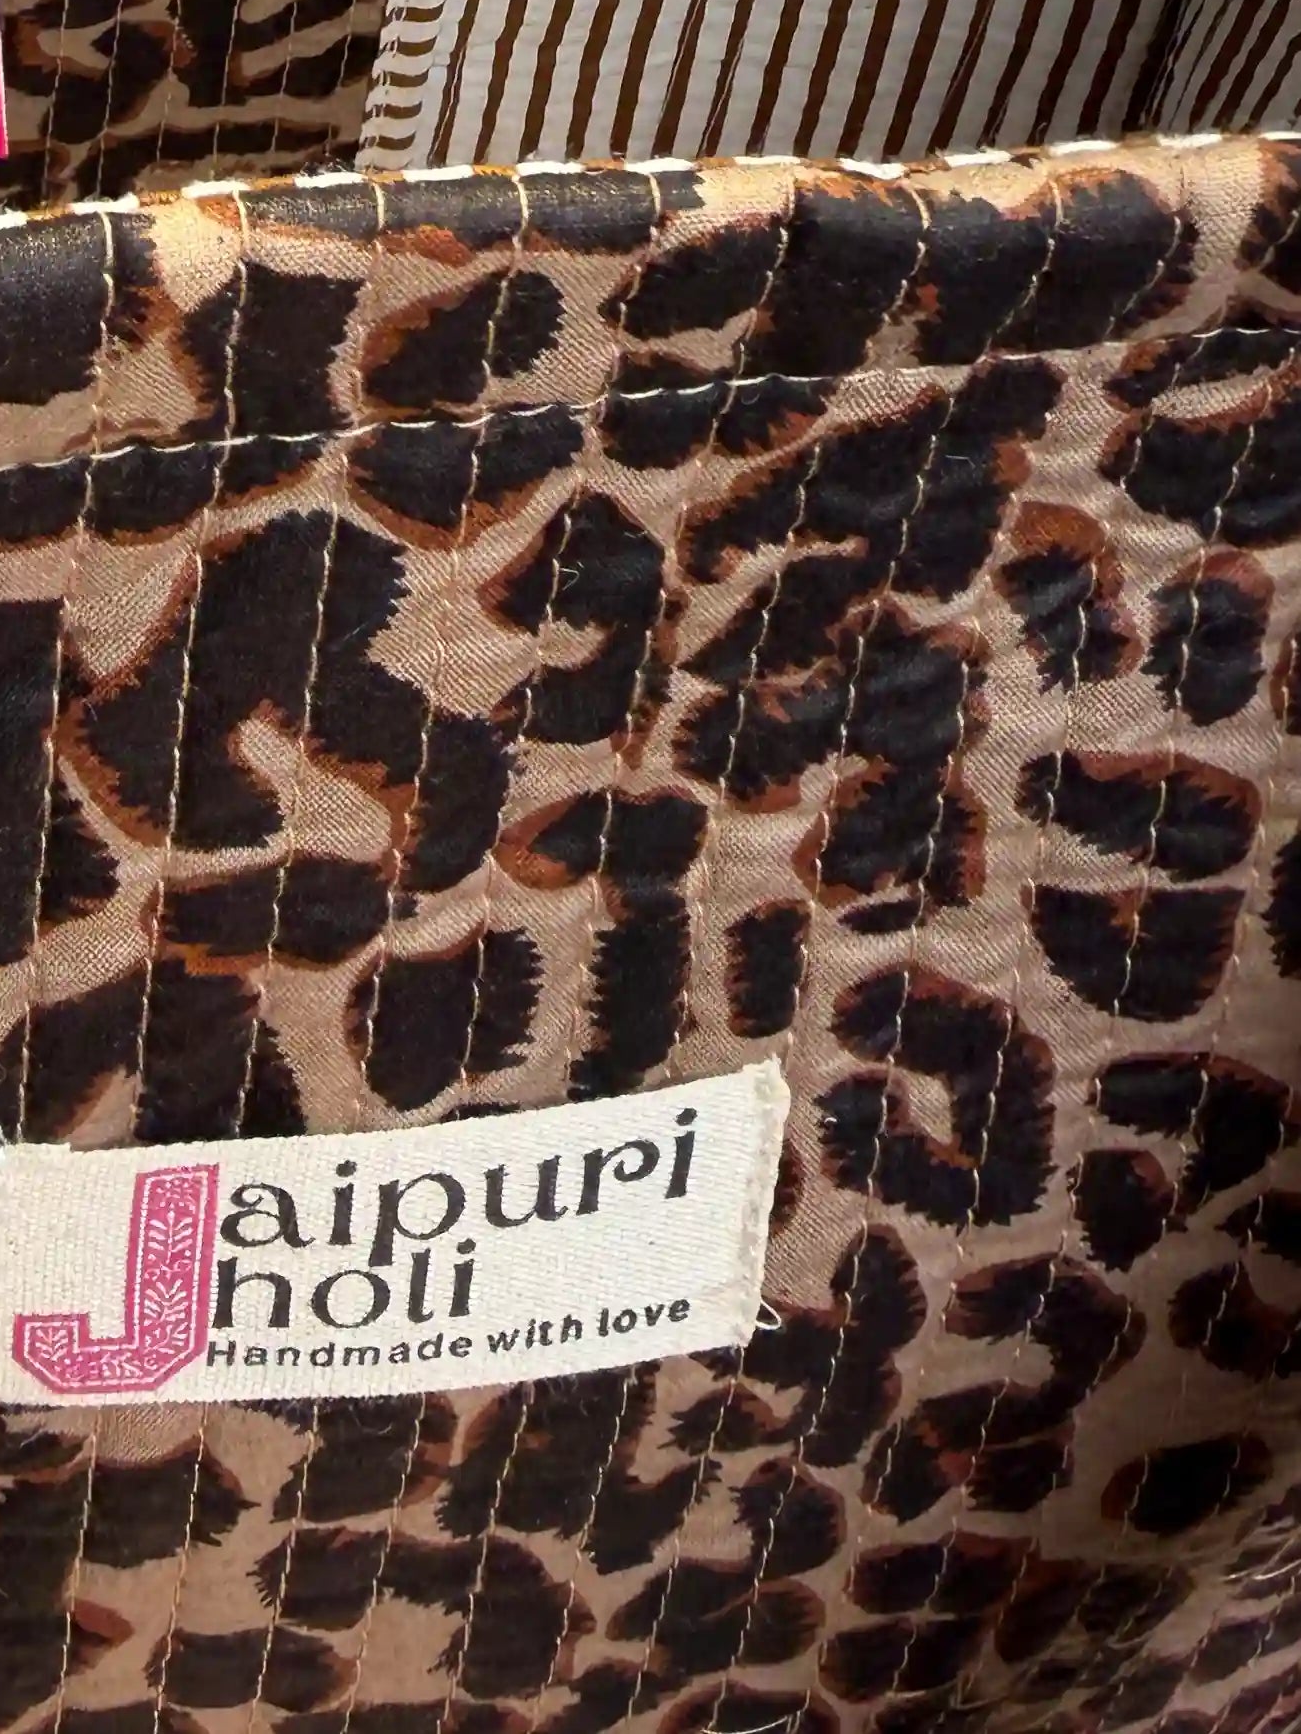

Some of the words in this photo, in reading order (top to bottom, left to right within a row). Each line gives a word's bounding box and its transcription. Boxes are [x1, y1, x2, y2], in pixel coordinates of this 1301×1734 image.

[211, 1239, 477, 1329] holi
[207, 1333, 473, 1369] Handmade
[489, 1319, 584, 1353] with
[597, 1297, 692, 1338] love
